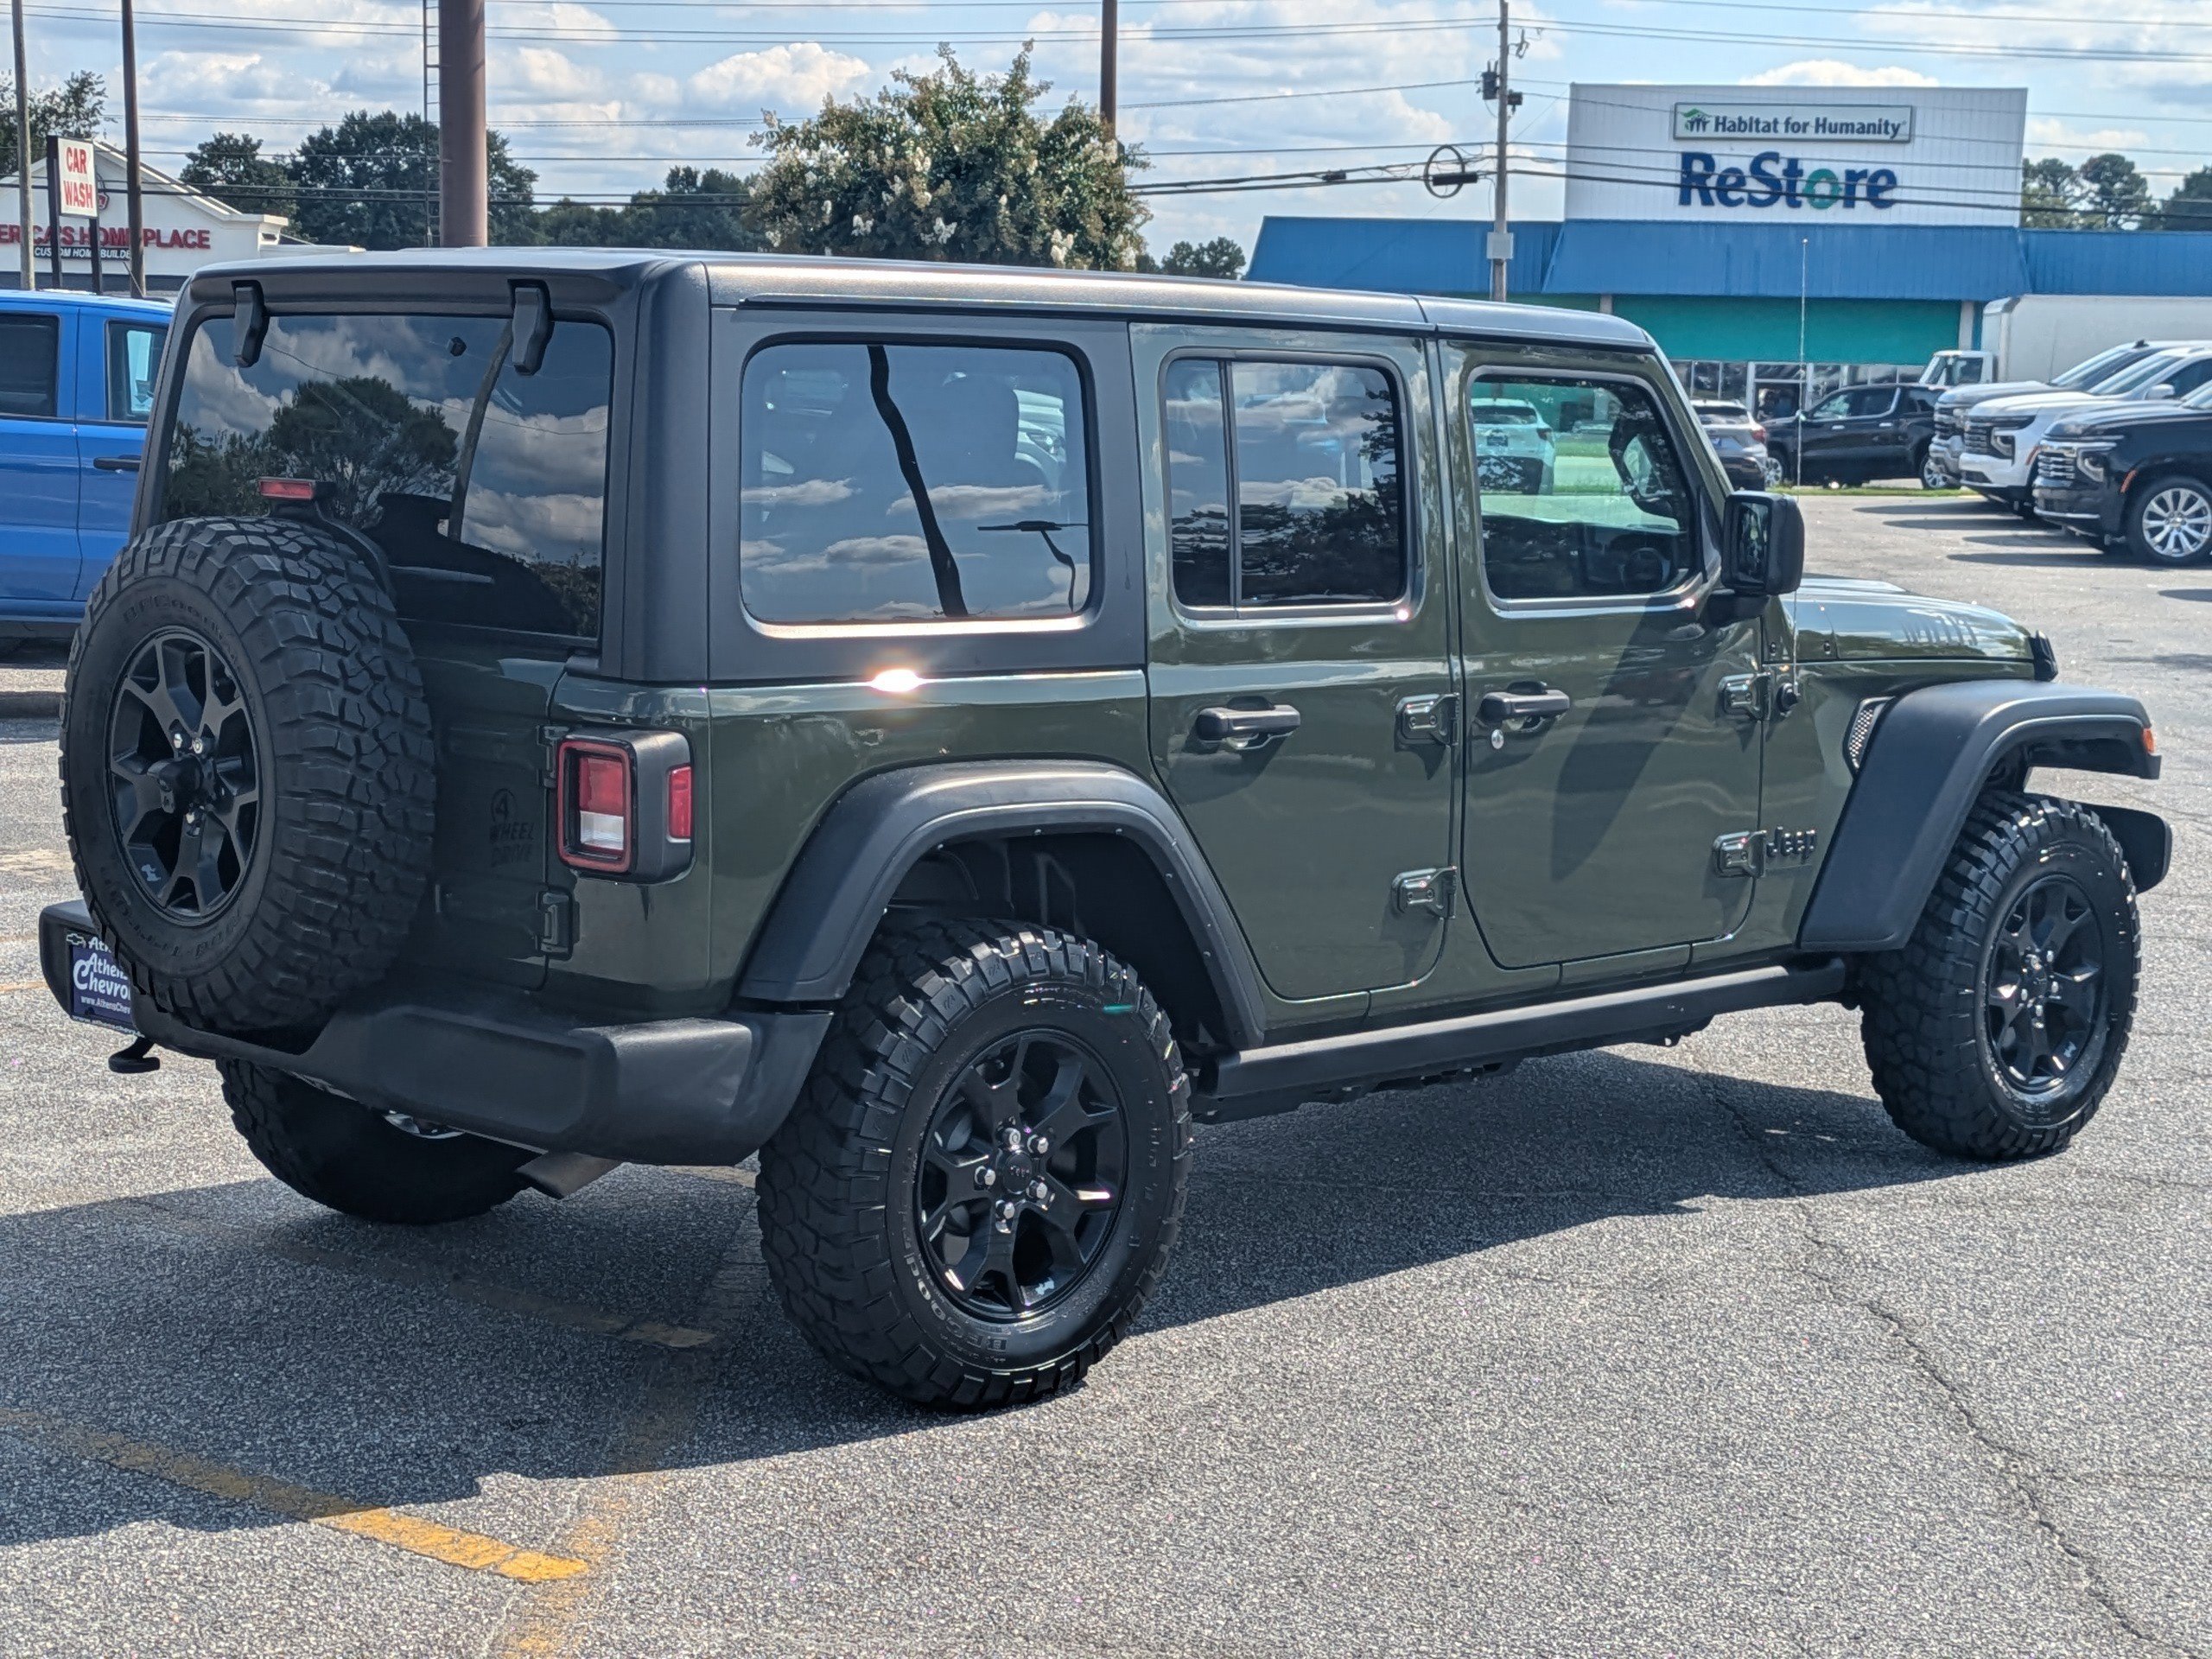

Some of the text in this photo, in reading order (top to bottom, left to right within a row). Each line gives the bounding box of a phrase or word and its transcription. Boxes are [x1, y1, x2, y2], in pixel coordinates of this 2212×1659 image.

[1713, 115, 1902, 139] Habitat for Humanity
[66, 146, 87, 175] CAR
[63, 180, 93, 208] WASH
[1678, 150, 1897, 210] ReStore
[35, 246, 71, 257] CUSOM
[73, 247, 92, 258] HOM
[143, 228, 211, 250] PLACE
[1766, 826, 1816, 865] Jeep
